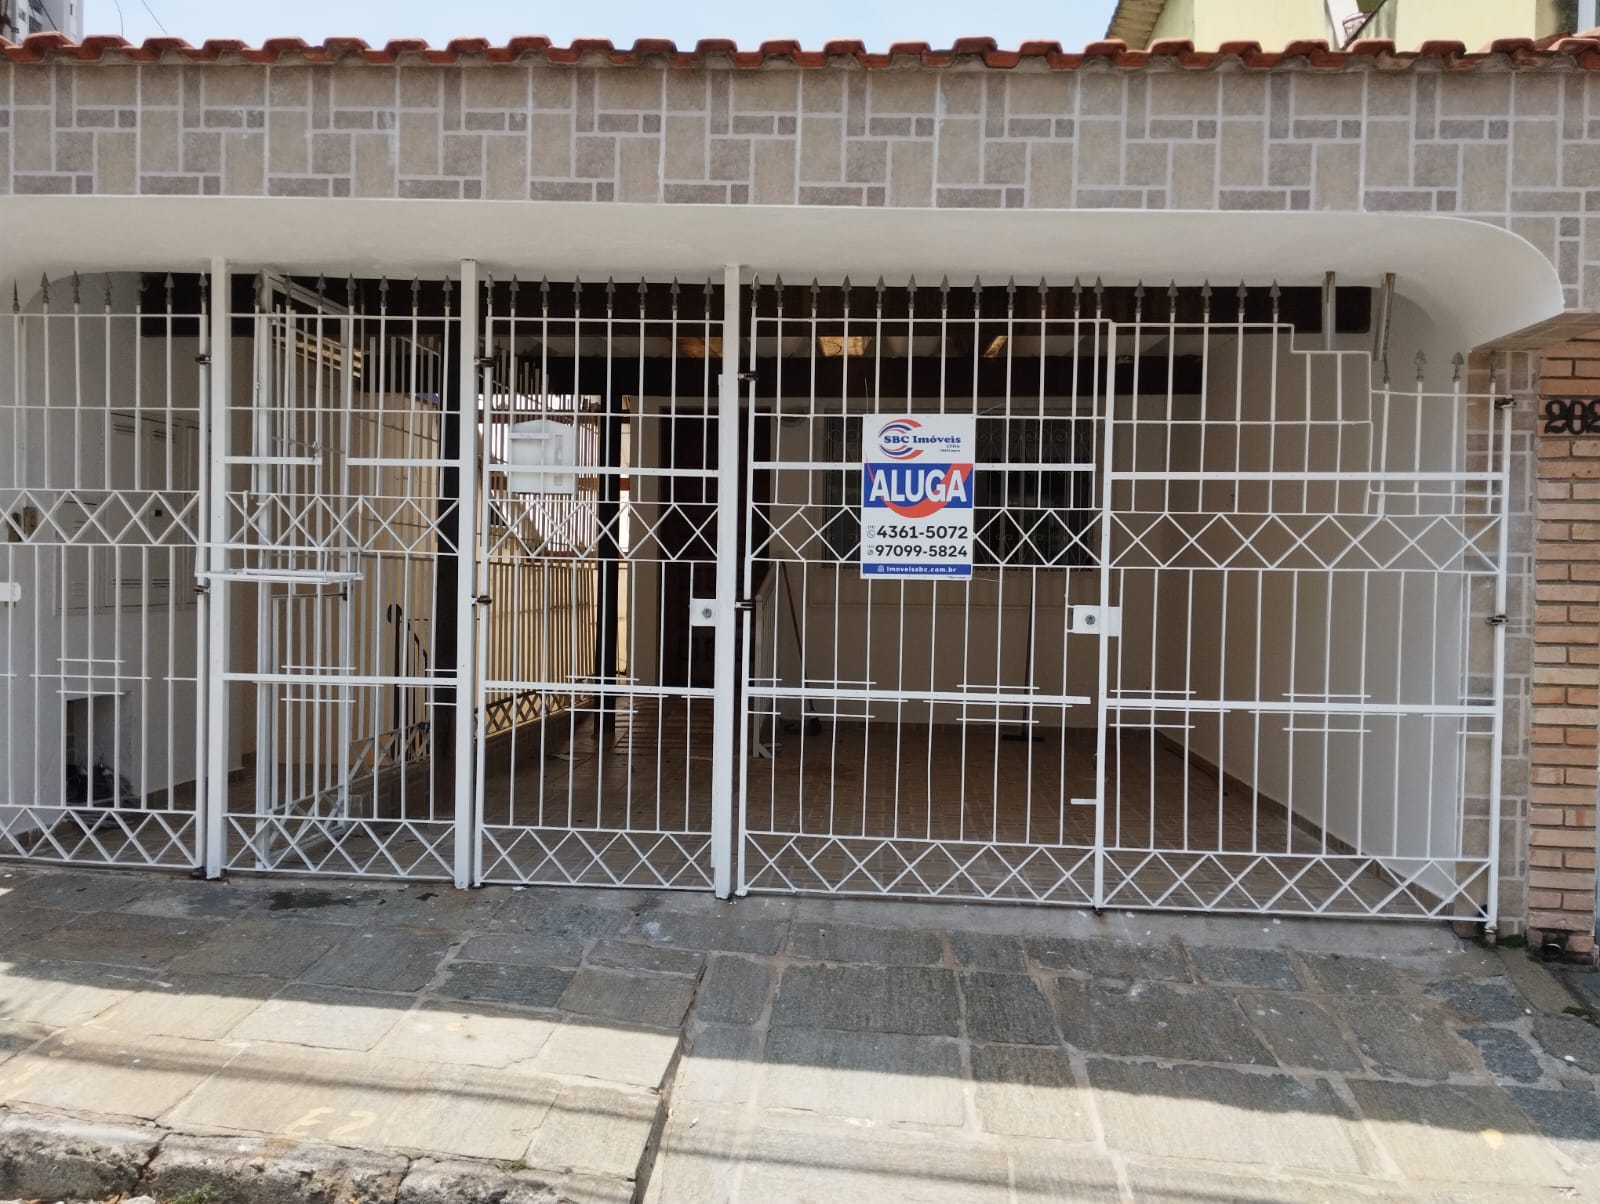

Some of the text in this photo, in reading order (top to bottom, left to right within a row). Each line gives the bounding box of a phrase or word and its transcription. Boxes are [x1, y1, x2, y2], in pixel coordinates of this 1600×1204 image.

[884, 435, 961, 444] SBC Imóveis
[869, 469, 967, 502] ALUGA
[877, 525, 968, 539] 4361-5072
[875, 544, 967, 557] 97099-5824
